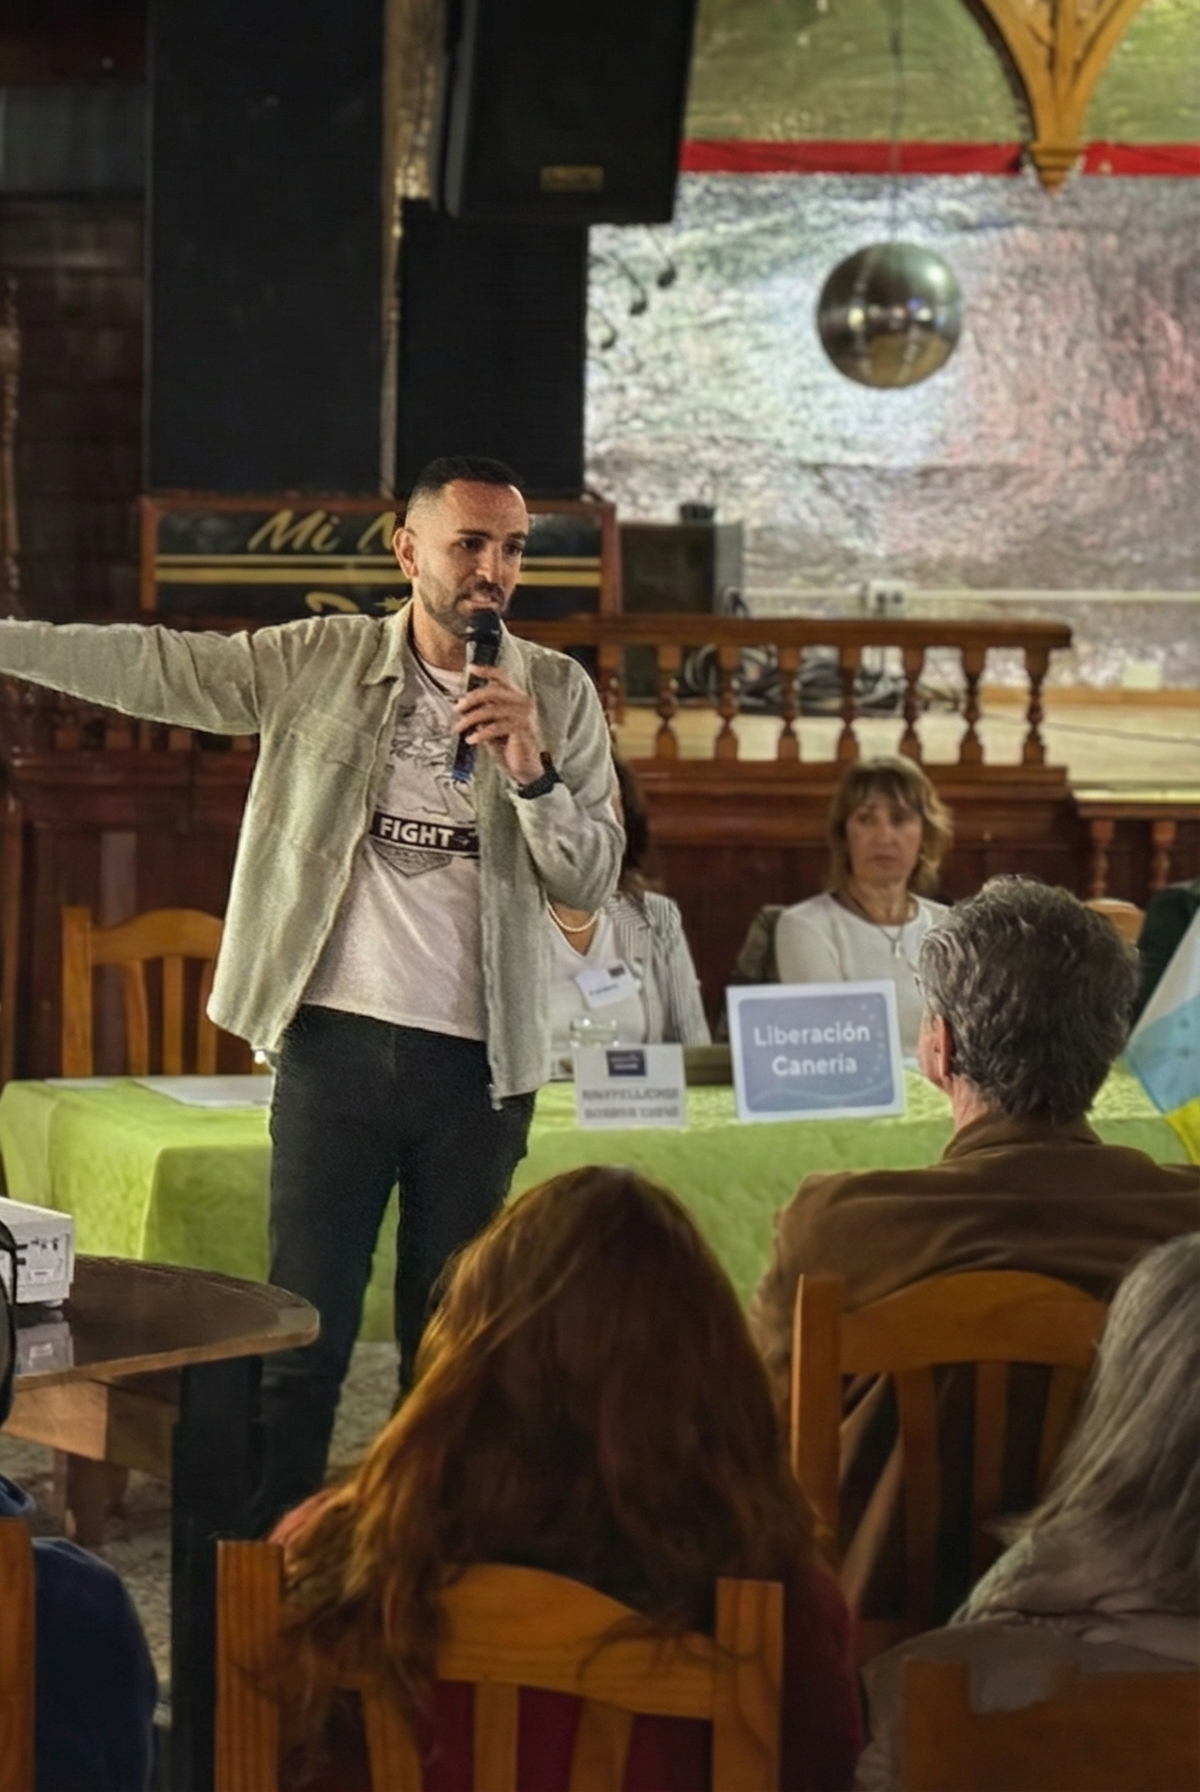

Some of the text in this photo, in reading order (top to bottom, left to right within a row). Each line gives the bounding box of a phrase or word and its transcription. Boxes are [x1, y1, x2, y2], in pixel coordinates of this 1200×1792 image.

[247, 508, 341, 552] Mi
[380, 817, 455, 848] FIGHT
[754, 1022, 870, 1046] Liberación
